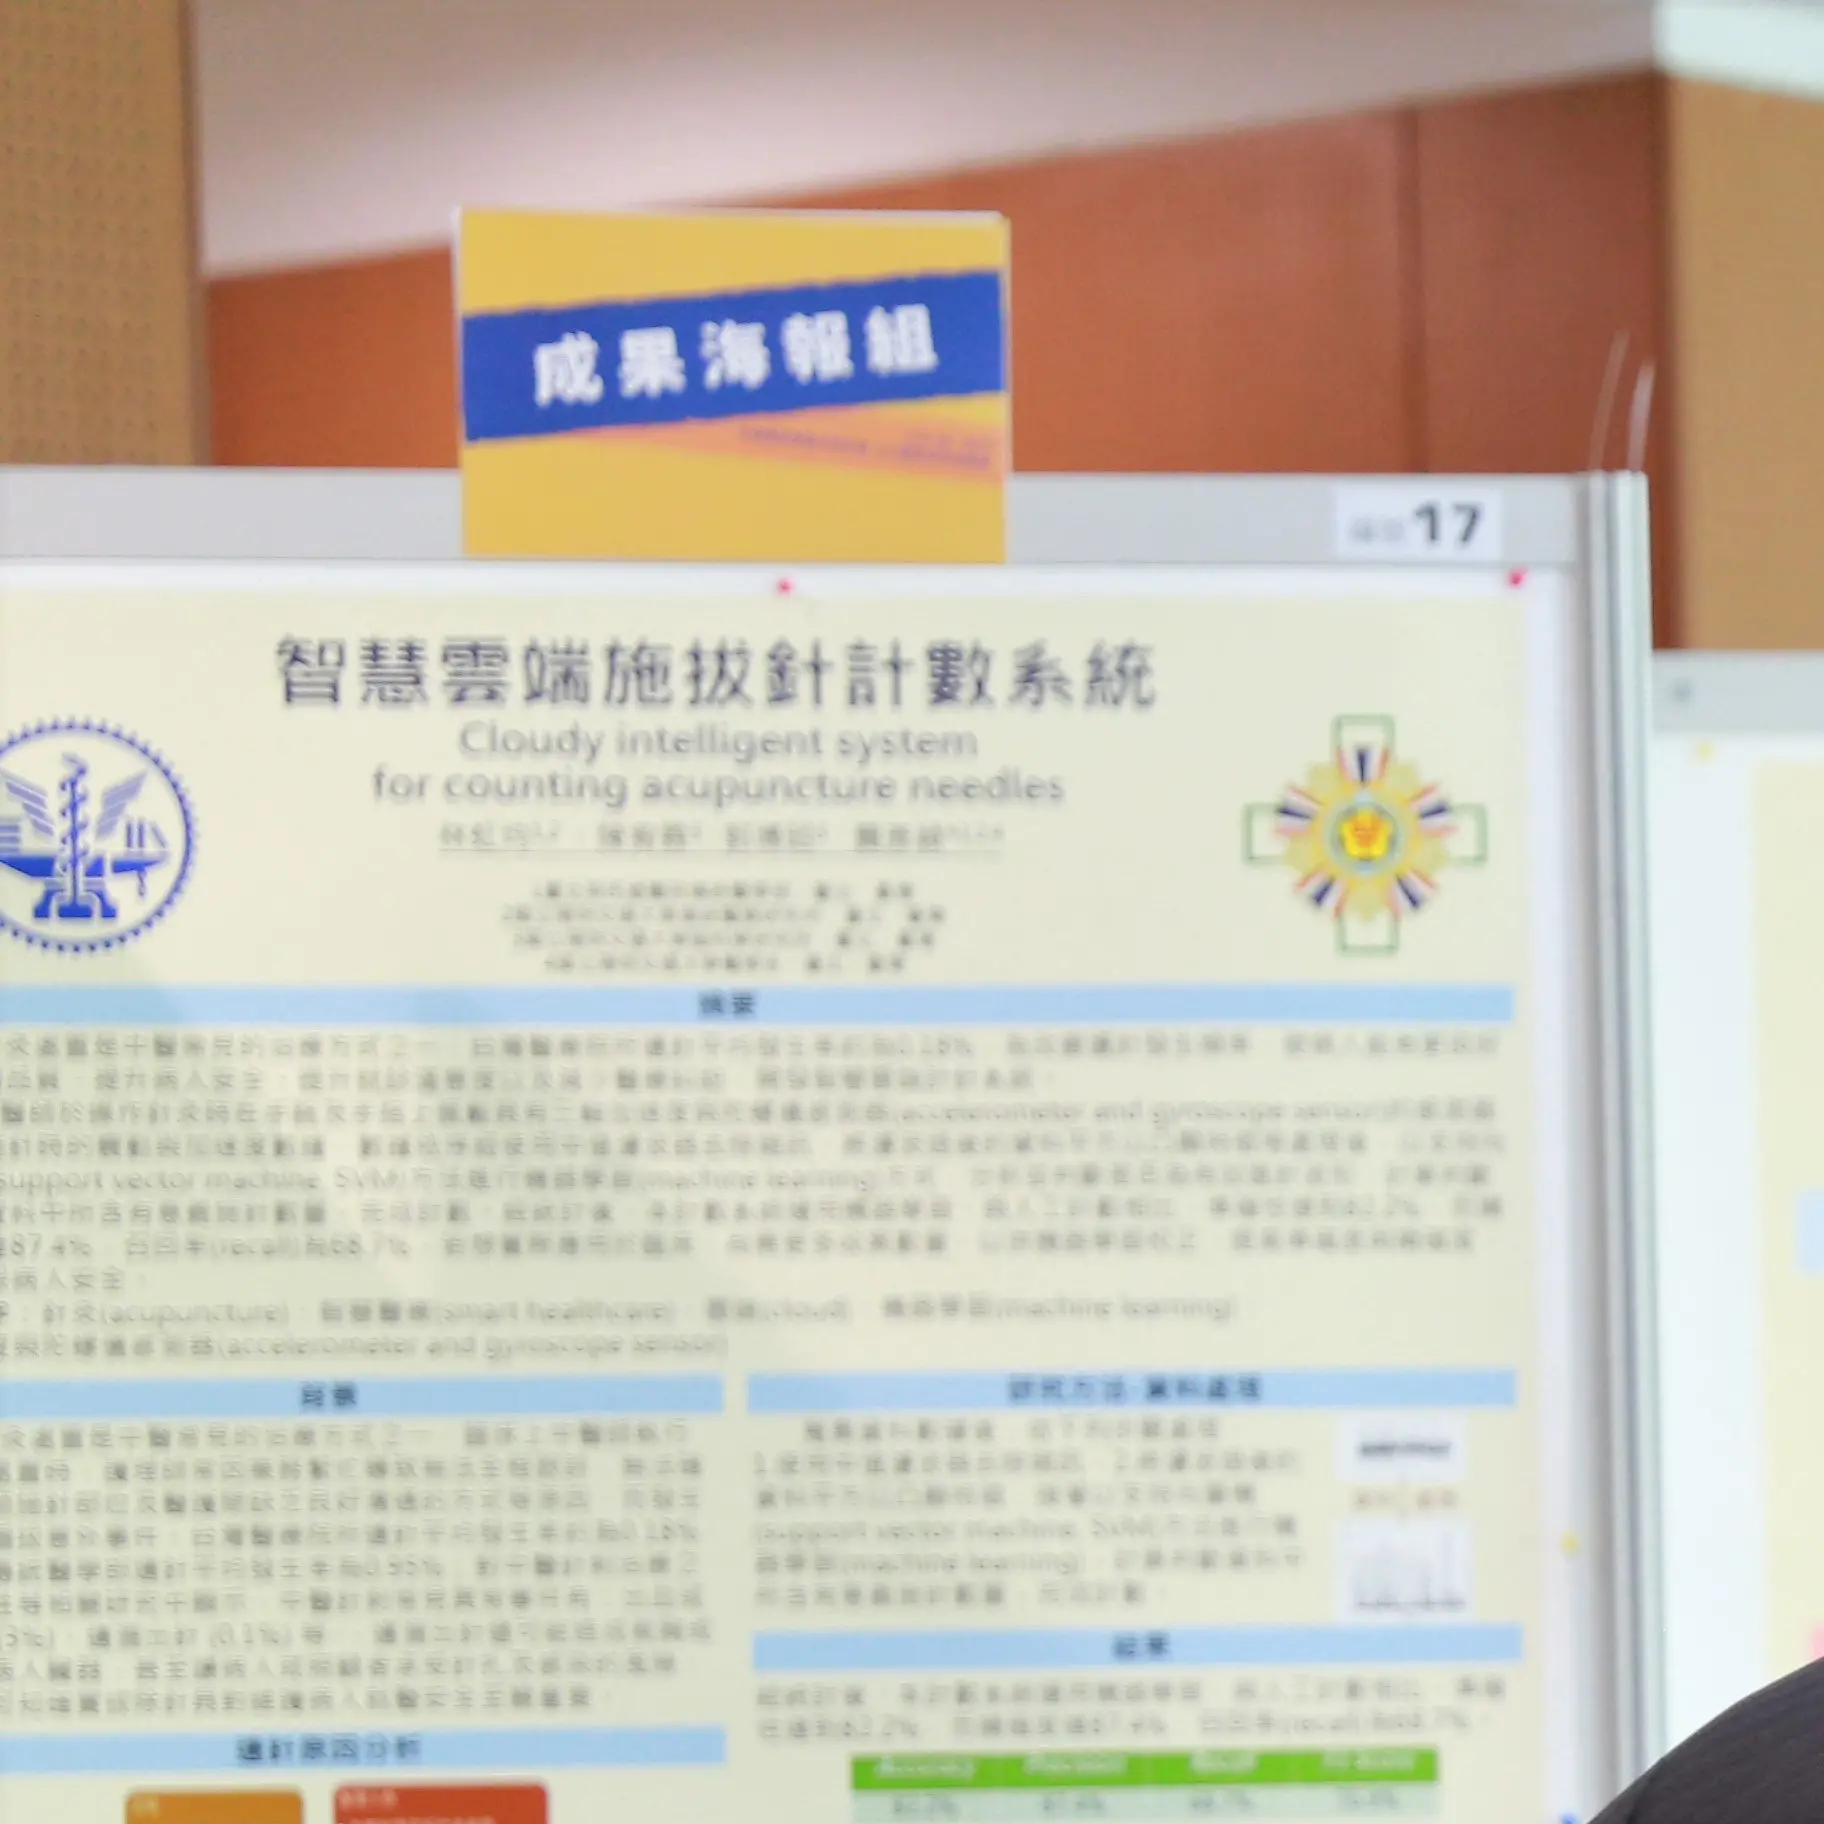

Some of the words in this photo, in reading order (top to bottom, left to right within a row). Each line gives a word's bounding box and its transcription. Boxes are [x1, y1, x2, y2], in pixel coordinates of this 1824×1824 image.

[534, 303, 938, 408] 成果海報組
[1412, 500, 1483, 546] 17
[275, 633, 1157, 713] 智慧雲端施拔針計數系統
[459, 720, 602, 765] Cloudy
[614, 720, 823, 765] intelligent
[835, 728, 977, 765] system
[372, 764, 427, 803] for
[443, 765, 627, 811] counting
[641, 767, 897, 810] acupuncture
[909, 765, 1064, 804] needles
